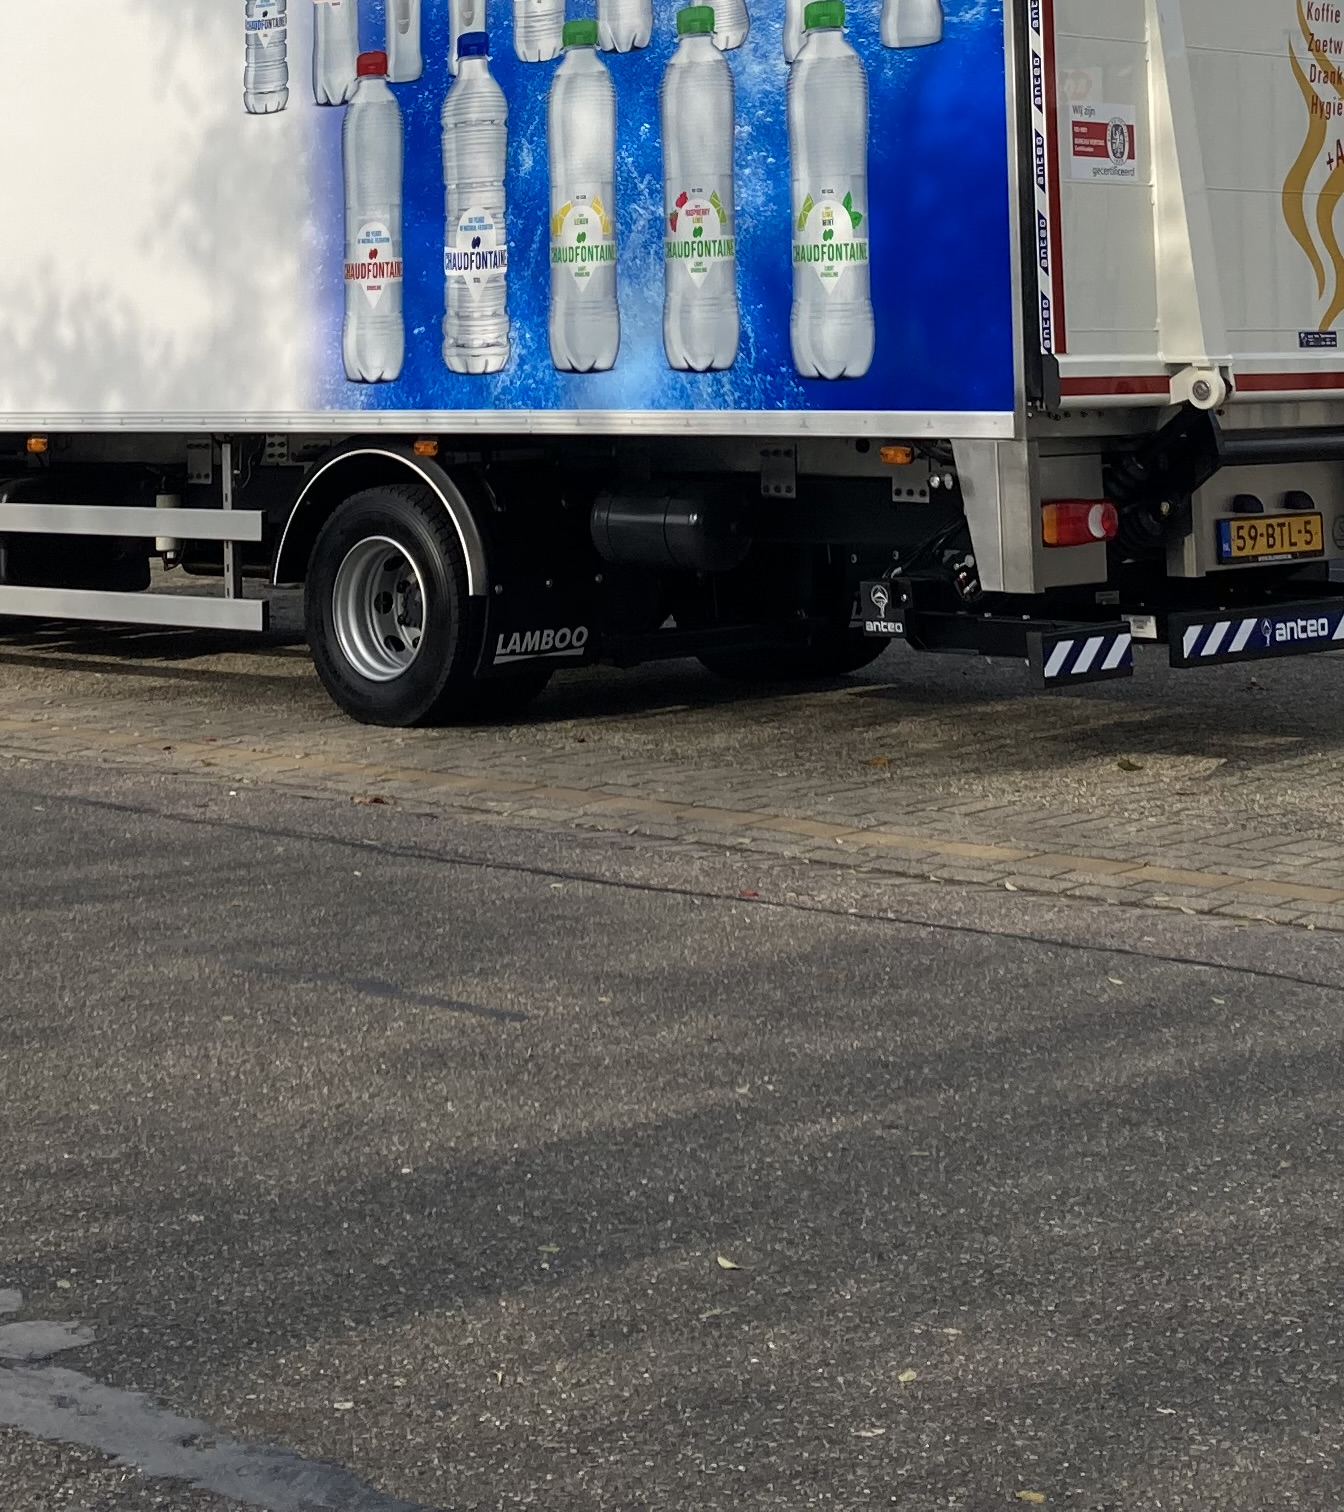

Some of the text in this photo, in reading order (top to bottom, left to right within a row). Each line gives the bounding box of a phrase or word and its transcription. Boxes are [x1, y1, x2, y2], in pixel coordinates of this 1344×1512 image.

[1307, 1, 1341, 23] Koffie
[1033, 57, 1042, 105] anteo
[1072, 105, 1084, 117] Wij
[1036, 136, 1044, 185] anteo
[1039, 218, 1048, 268] anteo
[1042, 299, 1051, 349] anteo
[1236, 520, 1314, 552] 59-BTL-5
[496, 626, 589, 655] LAMBOO
[865, 620, 904, 633] anteo
[1275, 617, 1329, 642] anteo
